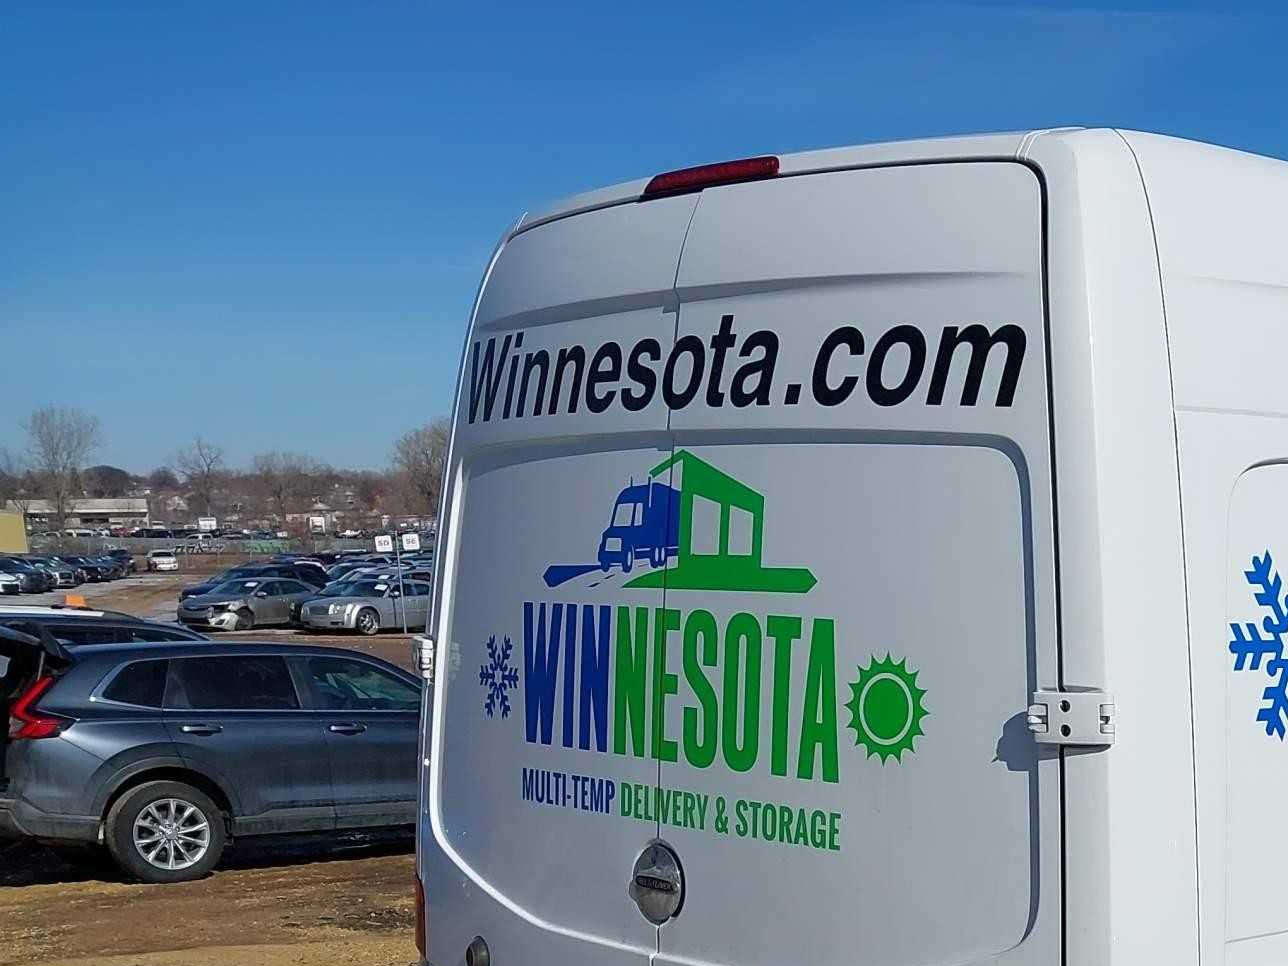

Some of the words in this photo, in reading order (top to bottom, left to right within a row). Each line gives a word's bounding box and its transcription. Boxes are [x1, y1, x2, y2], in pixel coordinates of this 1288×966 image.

[467, 314, 1027, 425] Winnesota.com
[523, 601, 840, 784] WINNESOTA
[522, 767, 616, 815] MULTI-TEMP
[620, 782, 709, 831] DELIVERY
[714, 796, 729, 835] &
[735, 799, 842, 852] STORAGE
